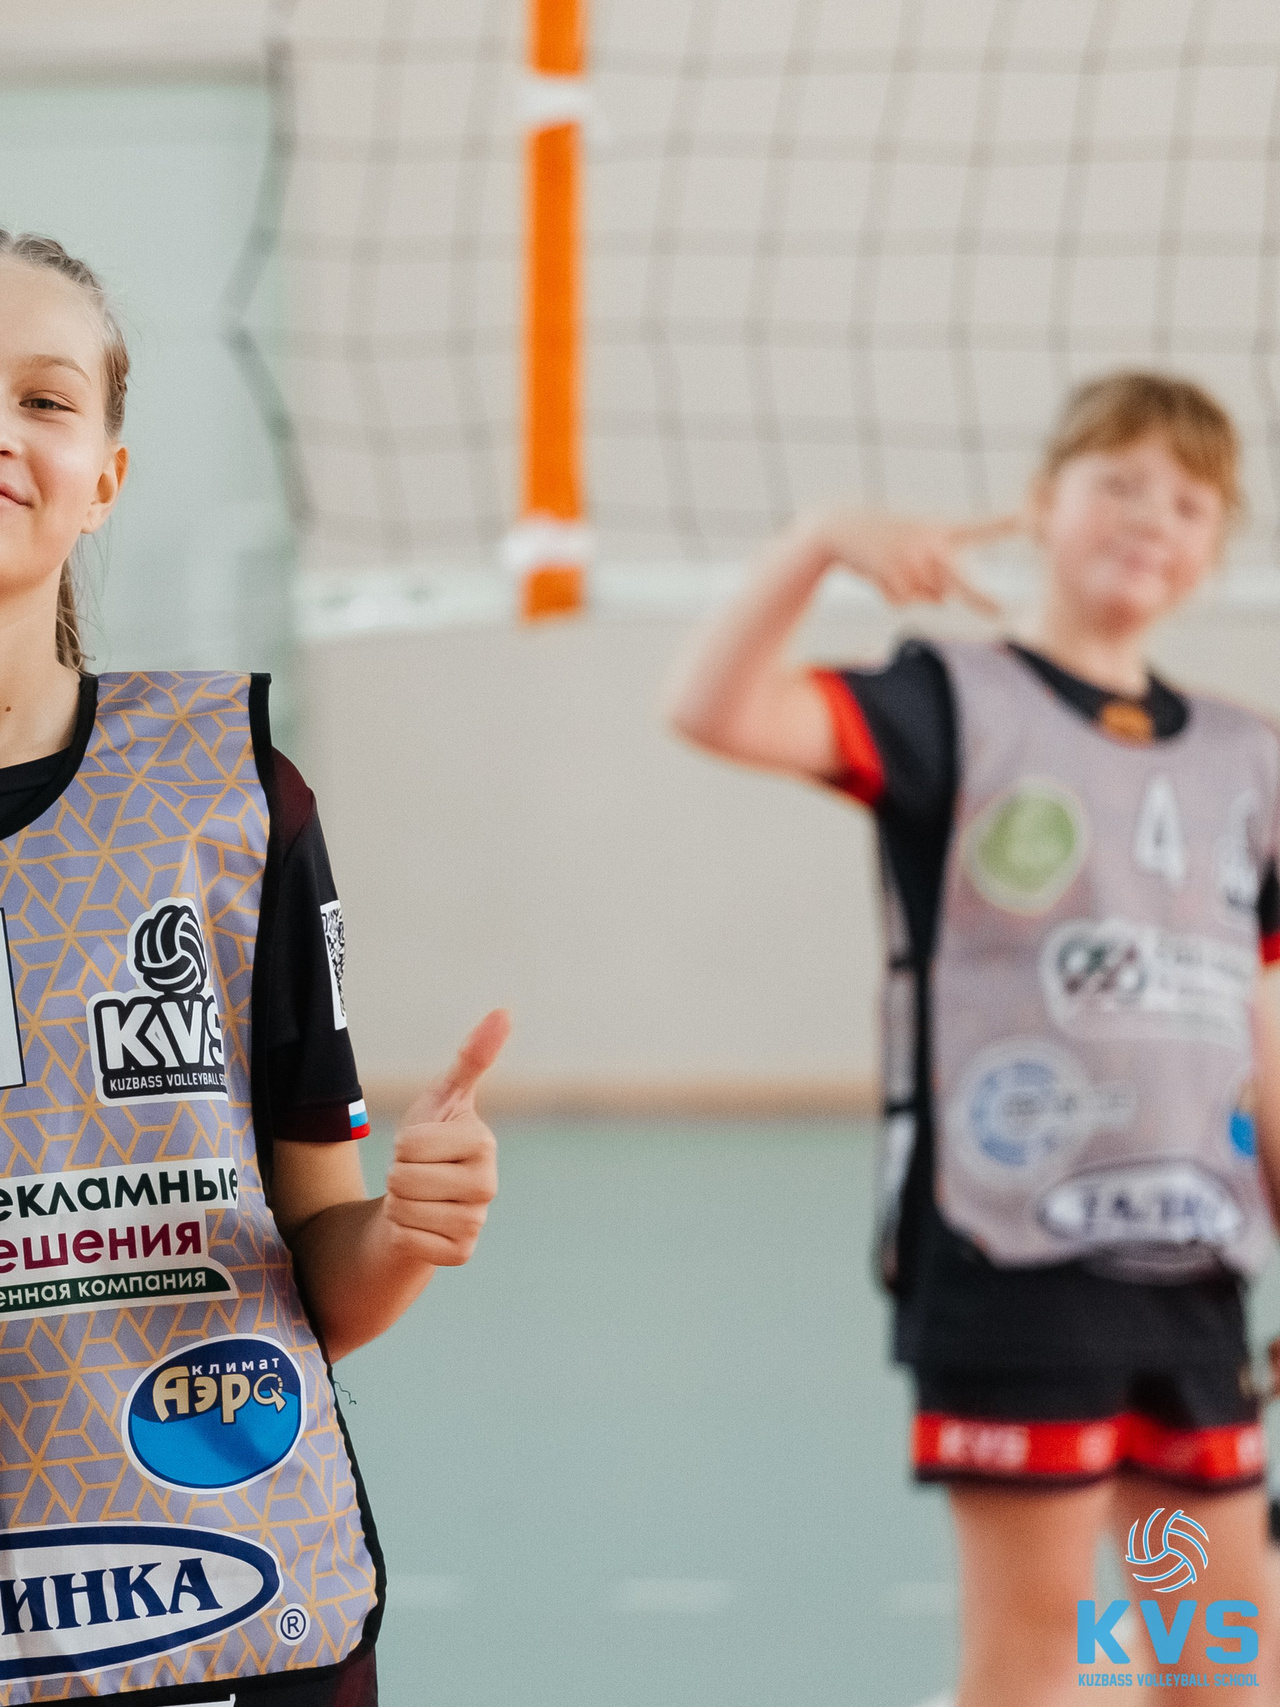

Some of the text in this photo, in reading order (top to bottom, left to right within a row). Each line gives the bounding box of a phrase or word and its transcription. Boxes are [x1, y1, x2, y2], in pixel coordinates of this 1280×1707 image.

[101, 1000, 225, 1069] KVS
[109, 1074, 163, 1092] KUZBASS
[166, 1071, 219, 1087] VOLLEYBALL
[77, 1270, 207, 1298] компания
[191, 1357, 280, 1376] климат
